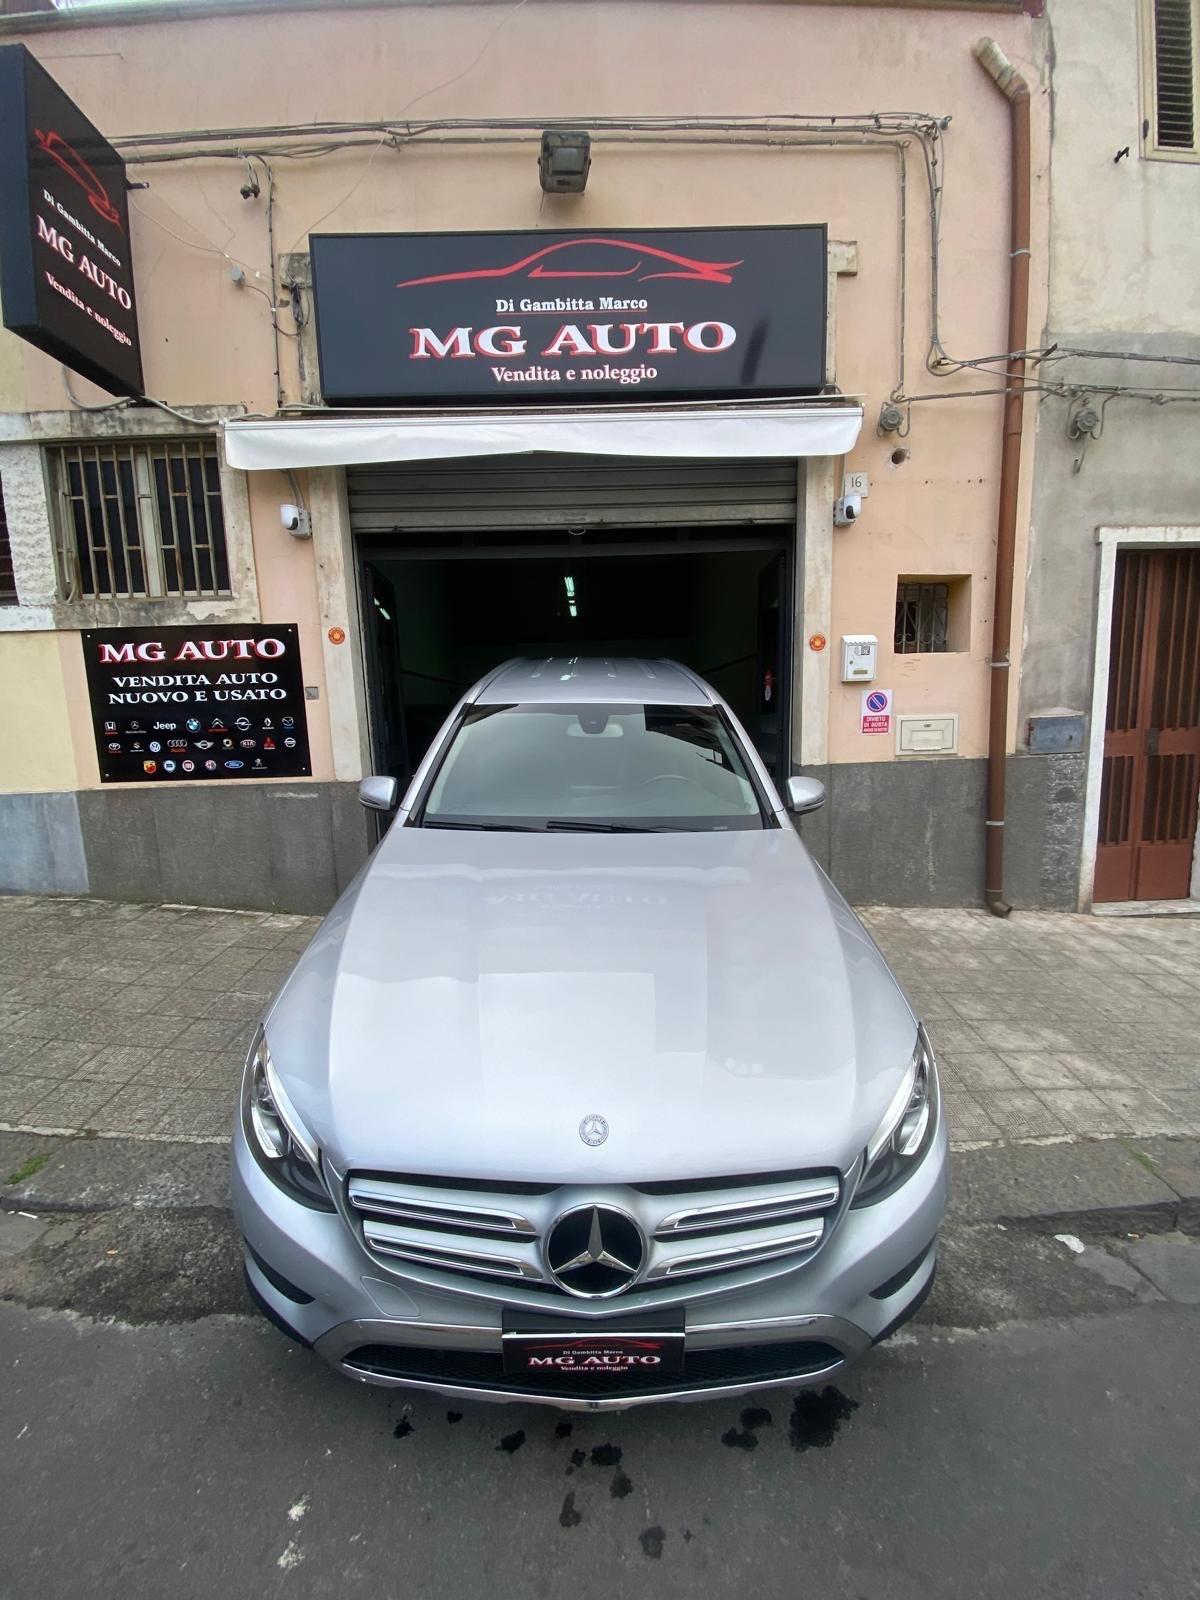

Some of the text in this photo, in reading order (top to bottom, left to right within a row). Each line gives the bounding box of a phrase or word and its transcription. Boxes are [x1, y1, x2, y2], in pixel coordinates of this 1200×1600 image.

[43, 188, 121, 267] Di Gambitta Marco
[36, 214, 132, 310] MG AUTO
[44, 270, 132, 346] Vendita e noleggio
[496, 297, 648, 312] Di Gambitta Marco
[409, 321, 737, 359] MG AUTO
[491, 364, 658, 384] Vendita e noleggio
[851, 475, 862, 488] 16
[99, 638, 286, 664] MG AUTO
[112, 672, 278, 688] VENDITA AUTO
[108, 688, 287, 705] NUOVO E USATO
[153, 721, 177, 731] Jeep
[528, 1355, 661, 1366] MG AUTO
